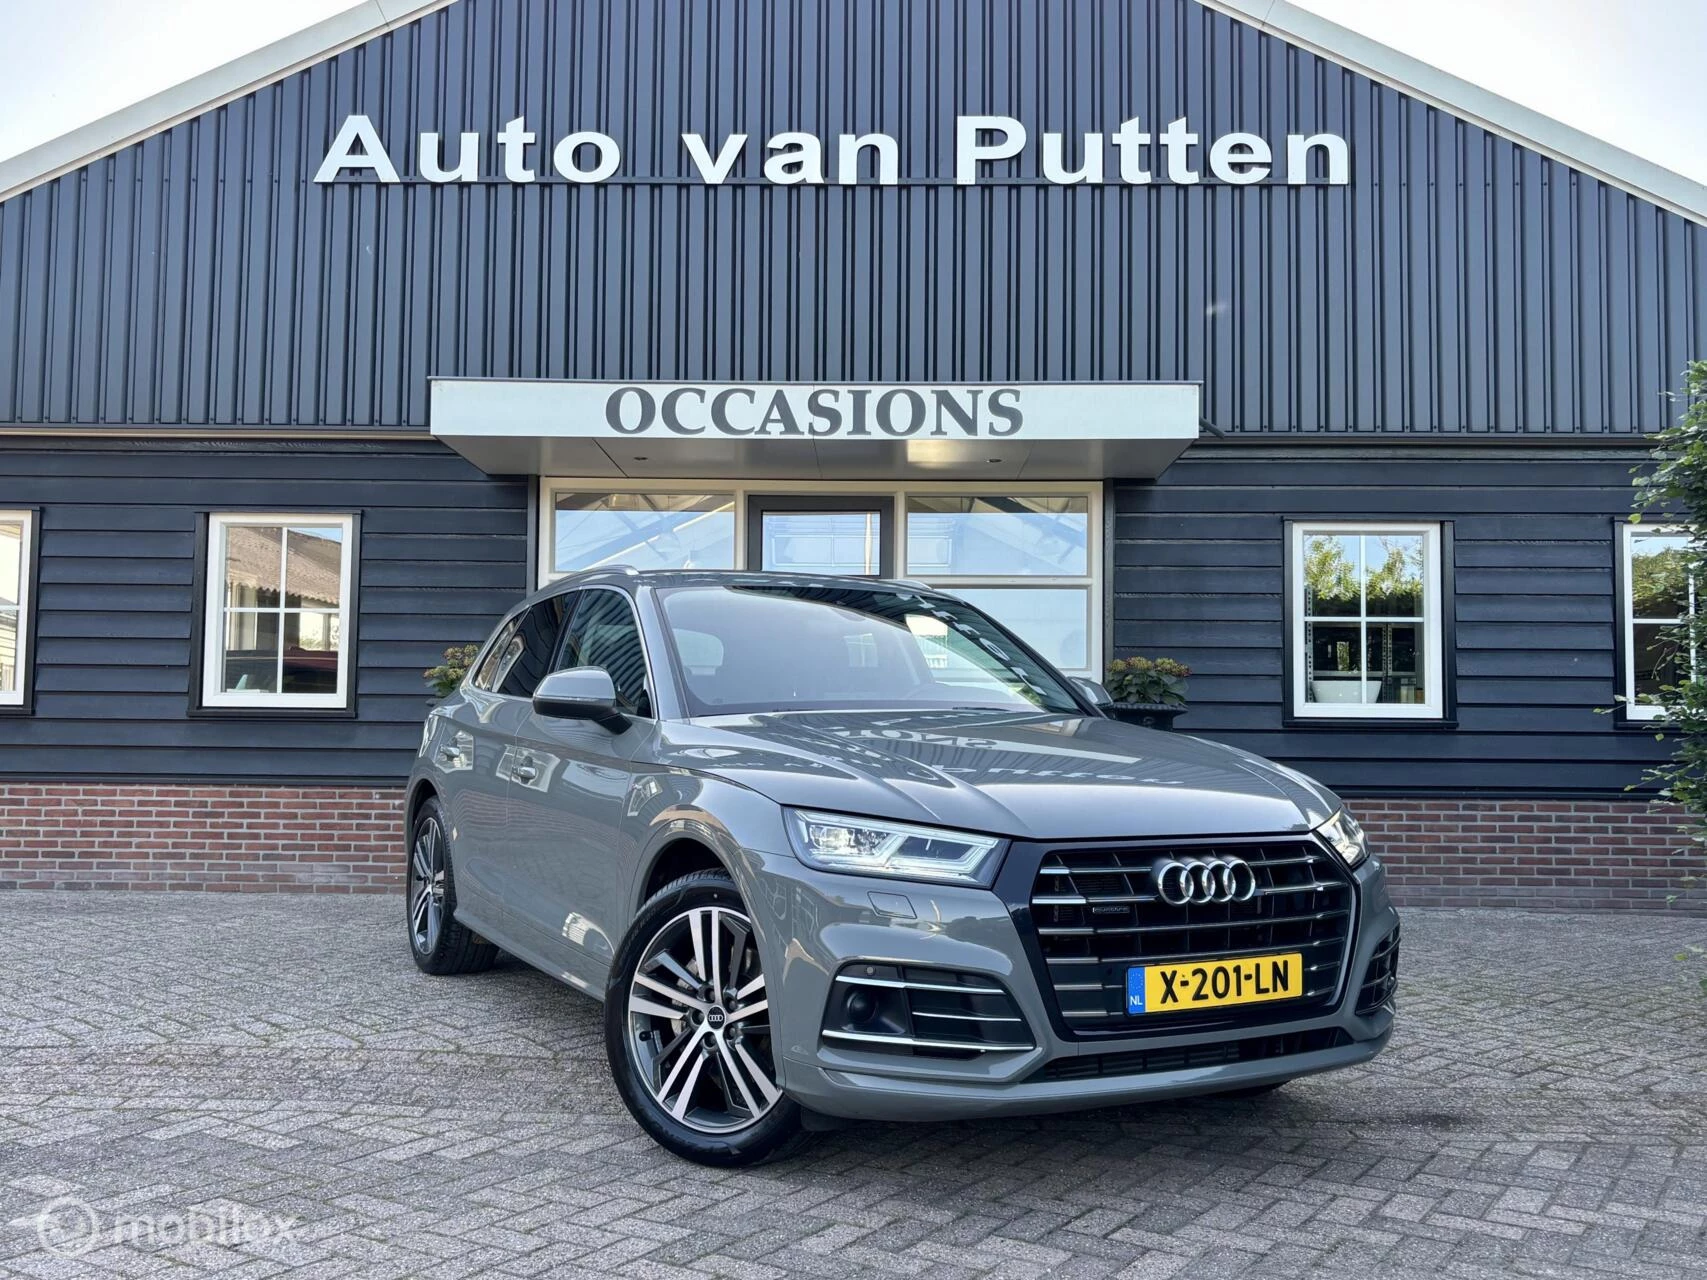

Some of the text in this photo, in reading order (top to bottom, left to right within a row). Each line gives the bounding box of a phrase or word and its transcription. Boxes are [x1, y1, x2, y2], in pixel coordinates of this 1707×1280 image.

[314, 114, 1350, 186] Auto van Putten
[606, 385, 1023, 438] OCCASIONS
[1129, 995, 1144, 1007] NL
[1160, 959, 1289, 1005] X-201-LN
